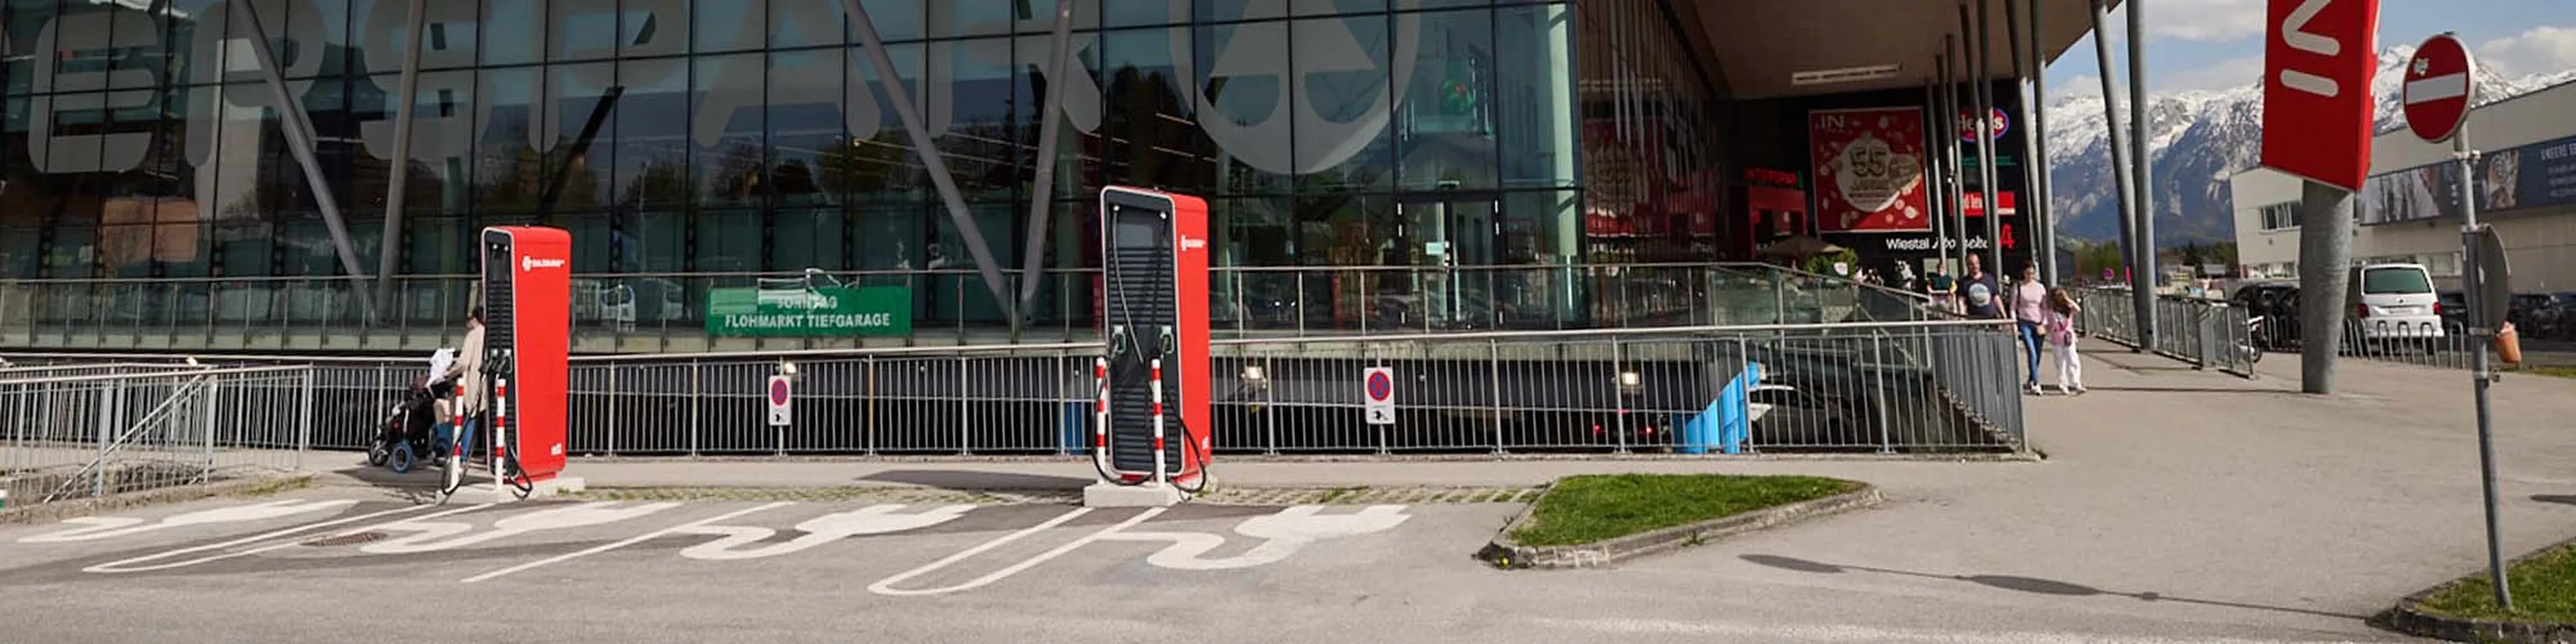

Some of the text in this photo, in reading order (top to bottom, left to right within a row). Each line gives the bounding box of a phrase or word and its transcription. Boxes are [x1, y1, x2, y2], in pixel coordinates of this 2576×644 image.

[0, 0, 1102, 174] ERSPAR
[1849, 146, 1886, 176] 55
[1886, 237, 1929, 250] Wiestal
[776, 296, 838, 309] SONNTAG
[724, 313, 891, 329] FLOHMARKT TIEFGARAGE
